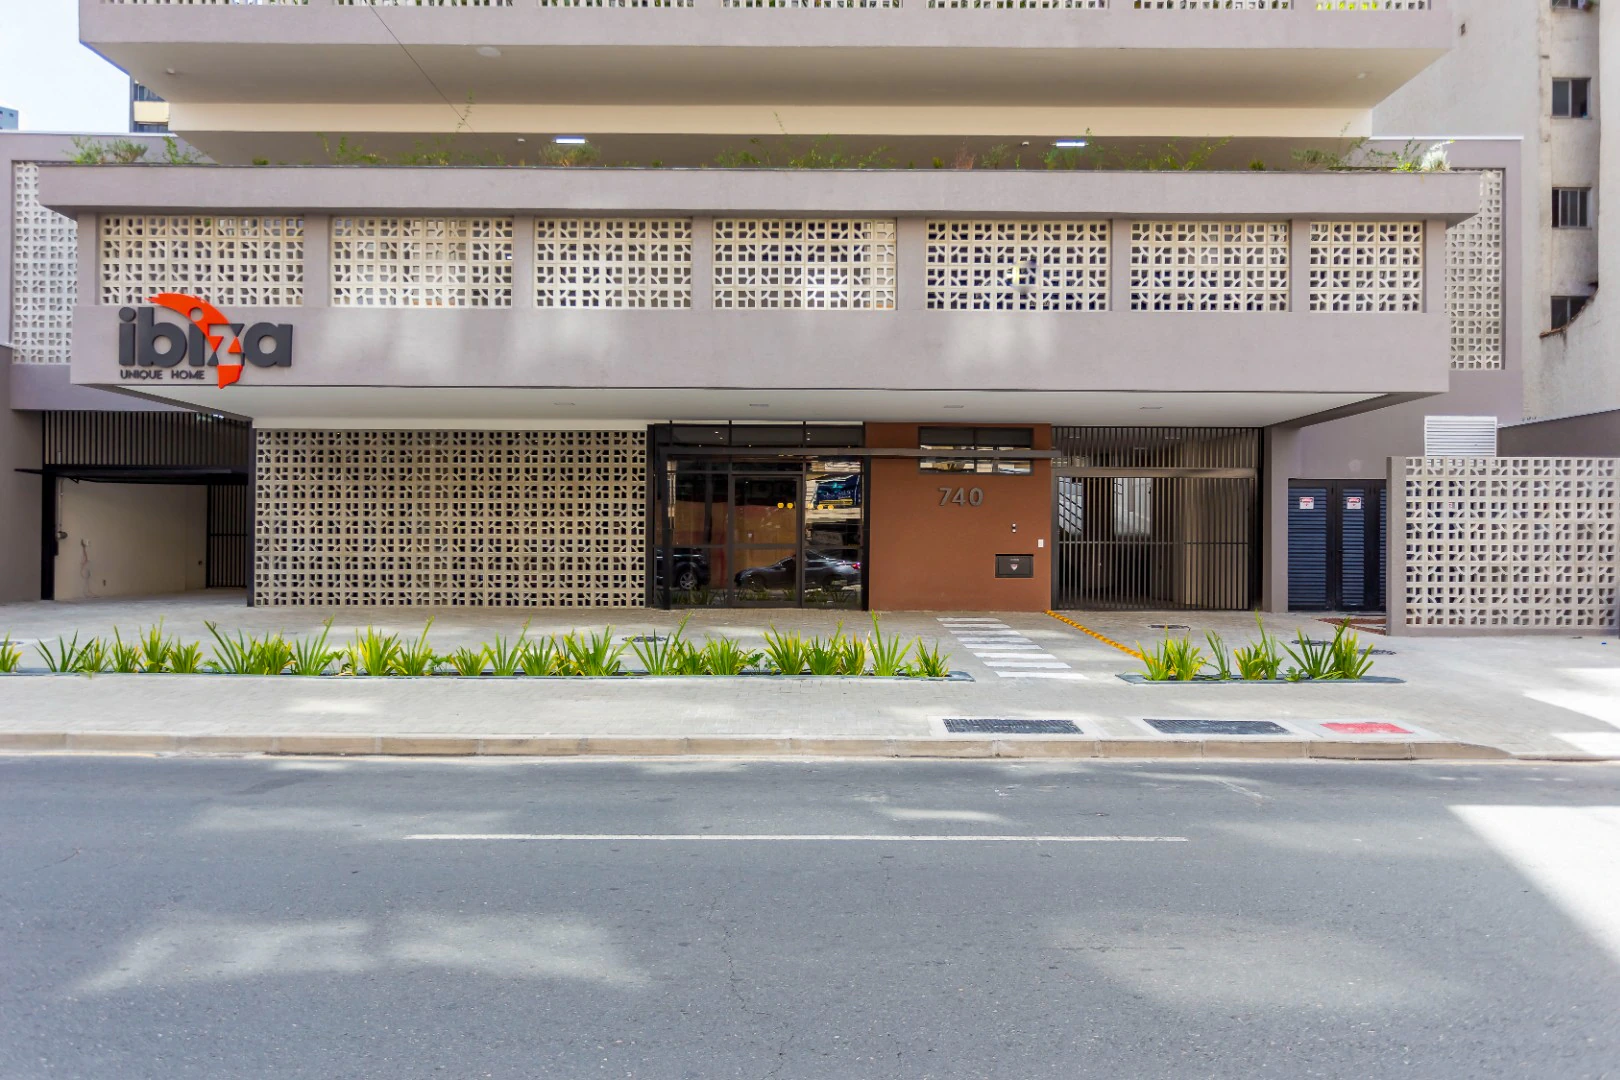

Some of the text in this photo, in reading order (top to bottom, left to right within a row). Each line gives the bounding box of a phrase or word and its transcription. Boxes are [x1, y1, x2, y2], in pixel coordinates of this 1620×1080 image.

[118, 306, 293, 368] ibiza
[120, 369, 205, 380] UNIQUE HOME
[938, 486, 984, 507] 740
